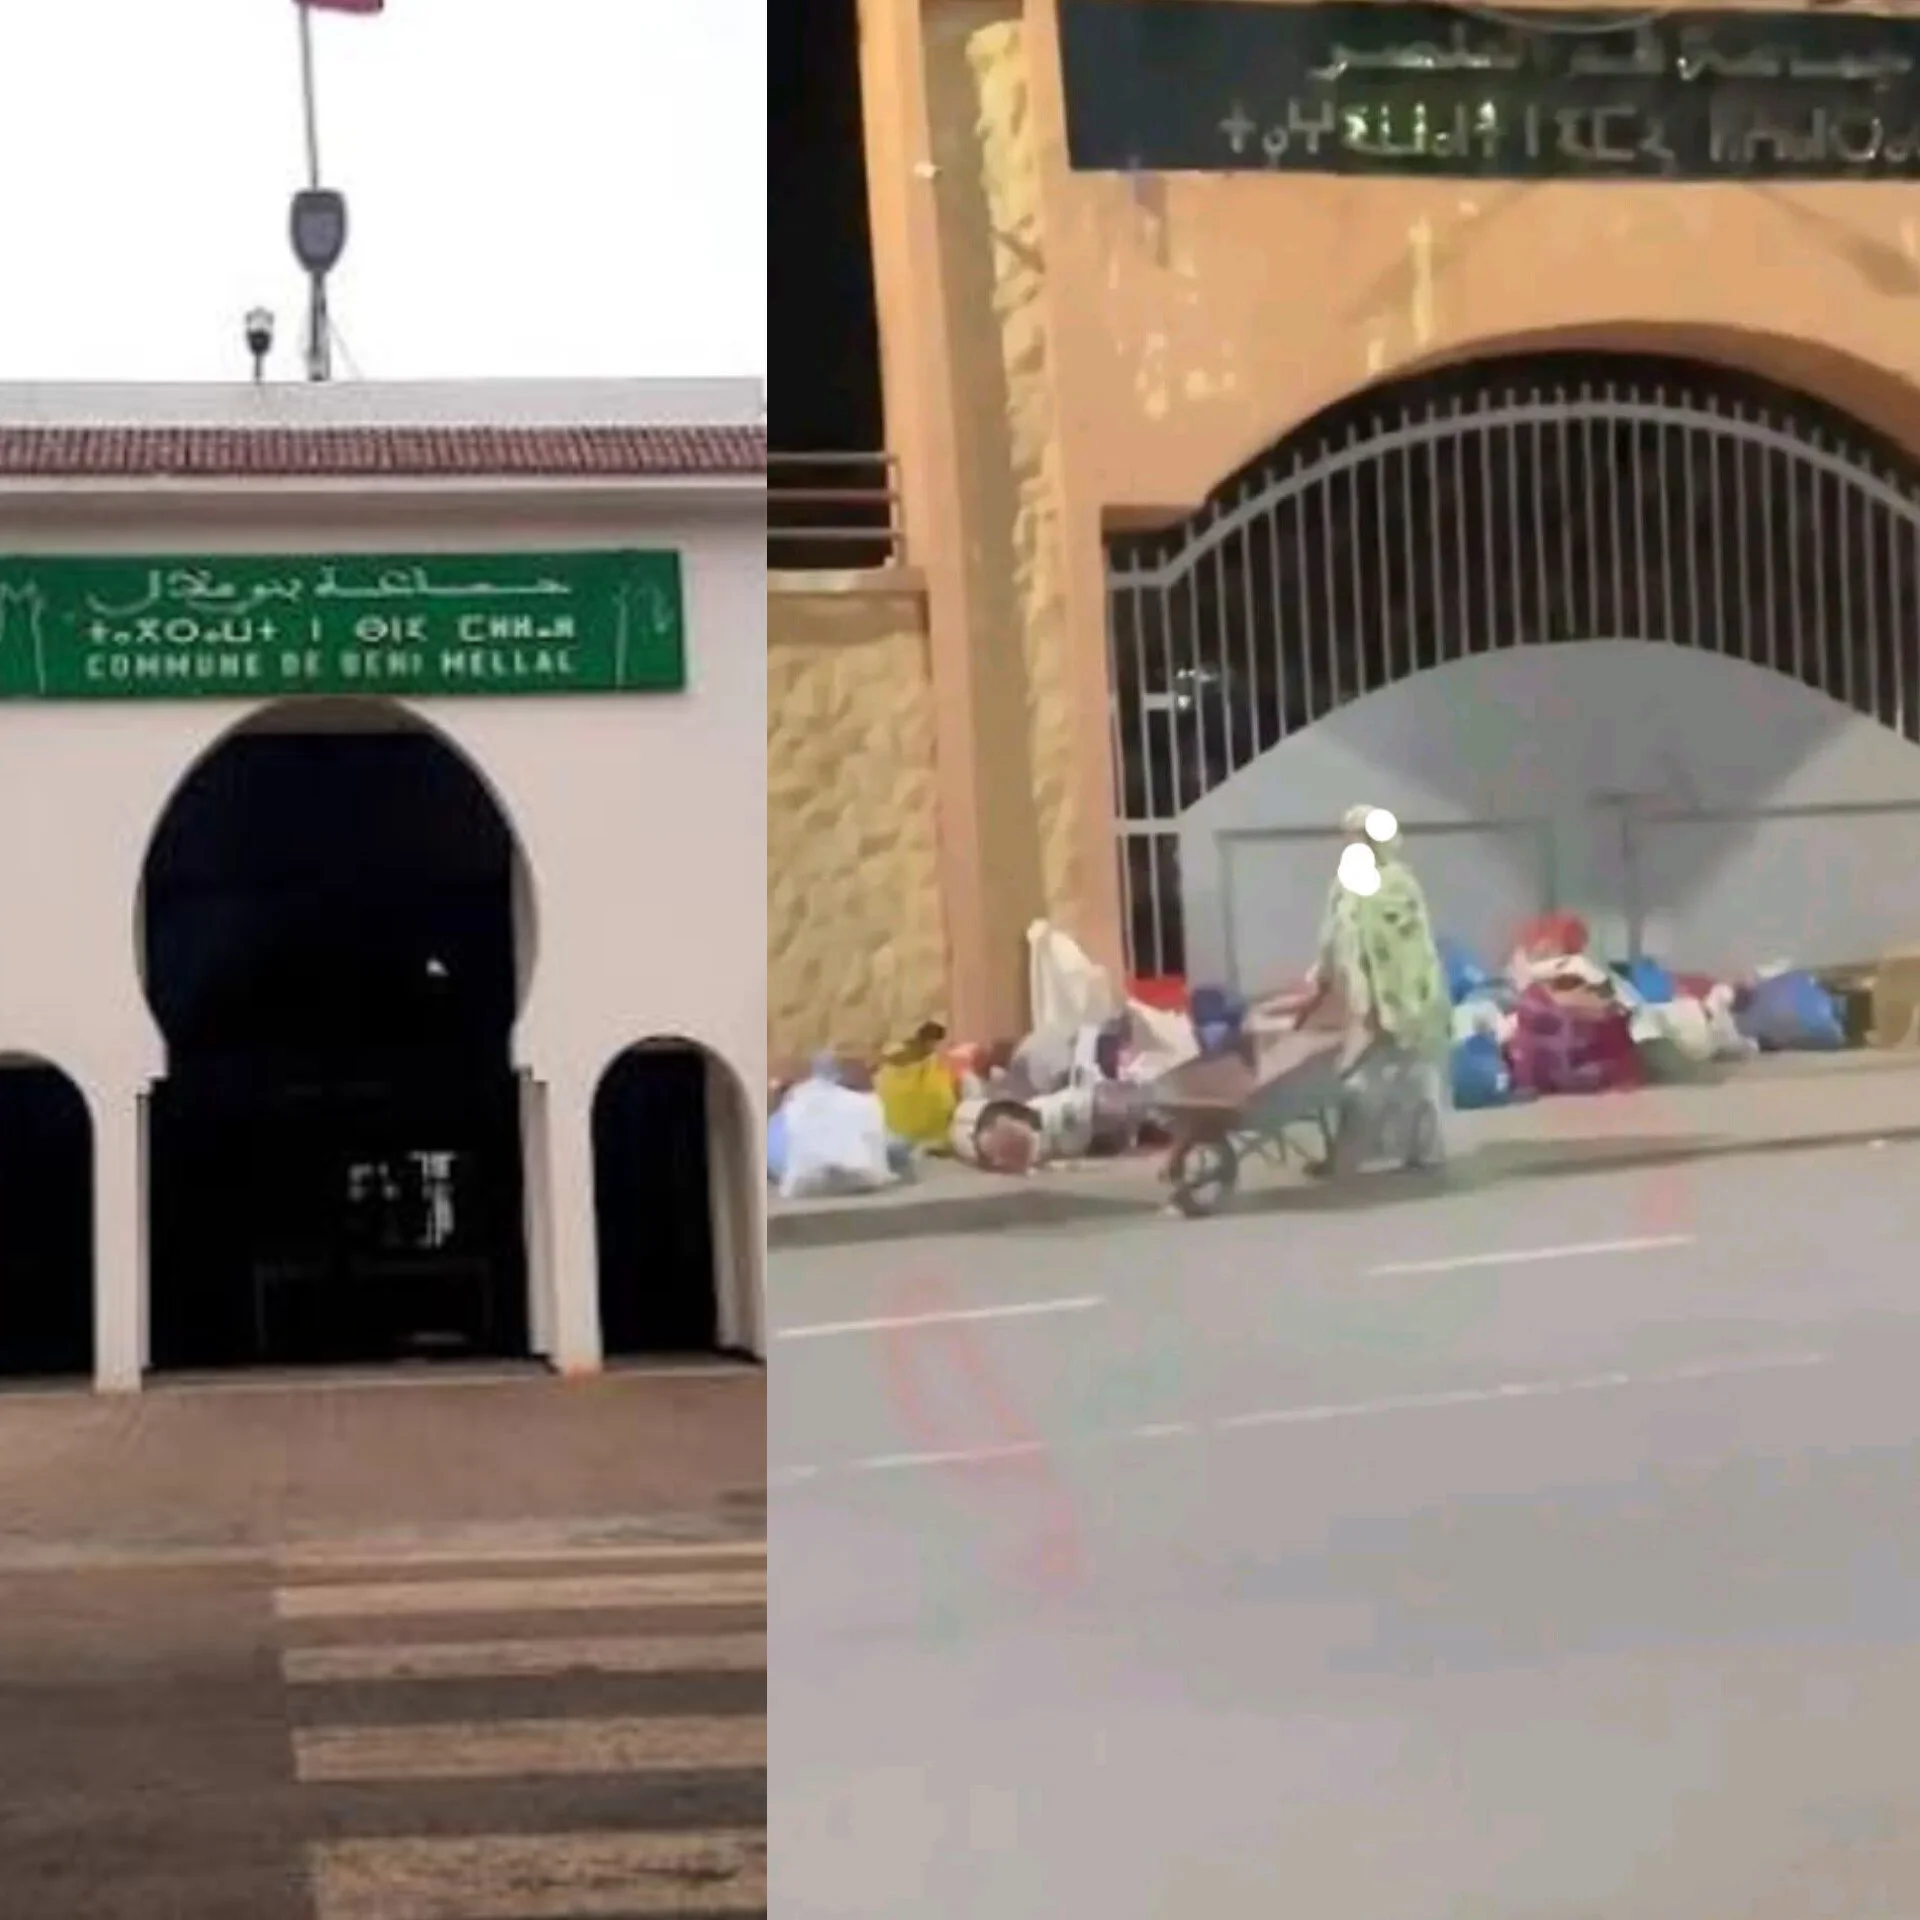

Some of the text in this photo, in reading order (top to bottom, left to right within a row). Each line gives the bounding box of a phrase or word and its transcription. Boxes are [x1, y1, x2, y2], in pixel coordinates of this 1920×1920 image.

[86, 646, 575, 681] COMMUNE DE BENI MELLAL
